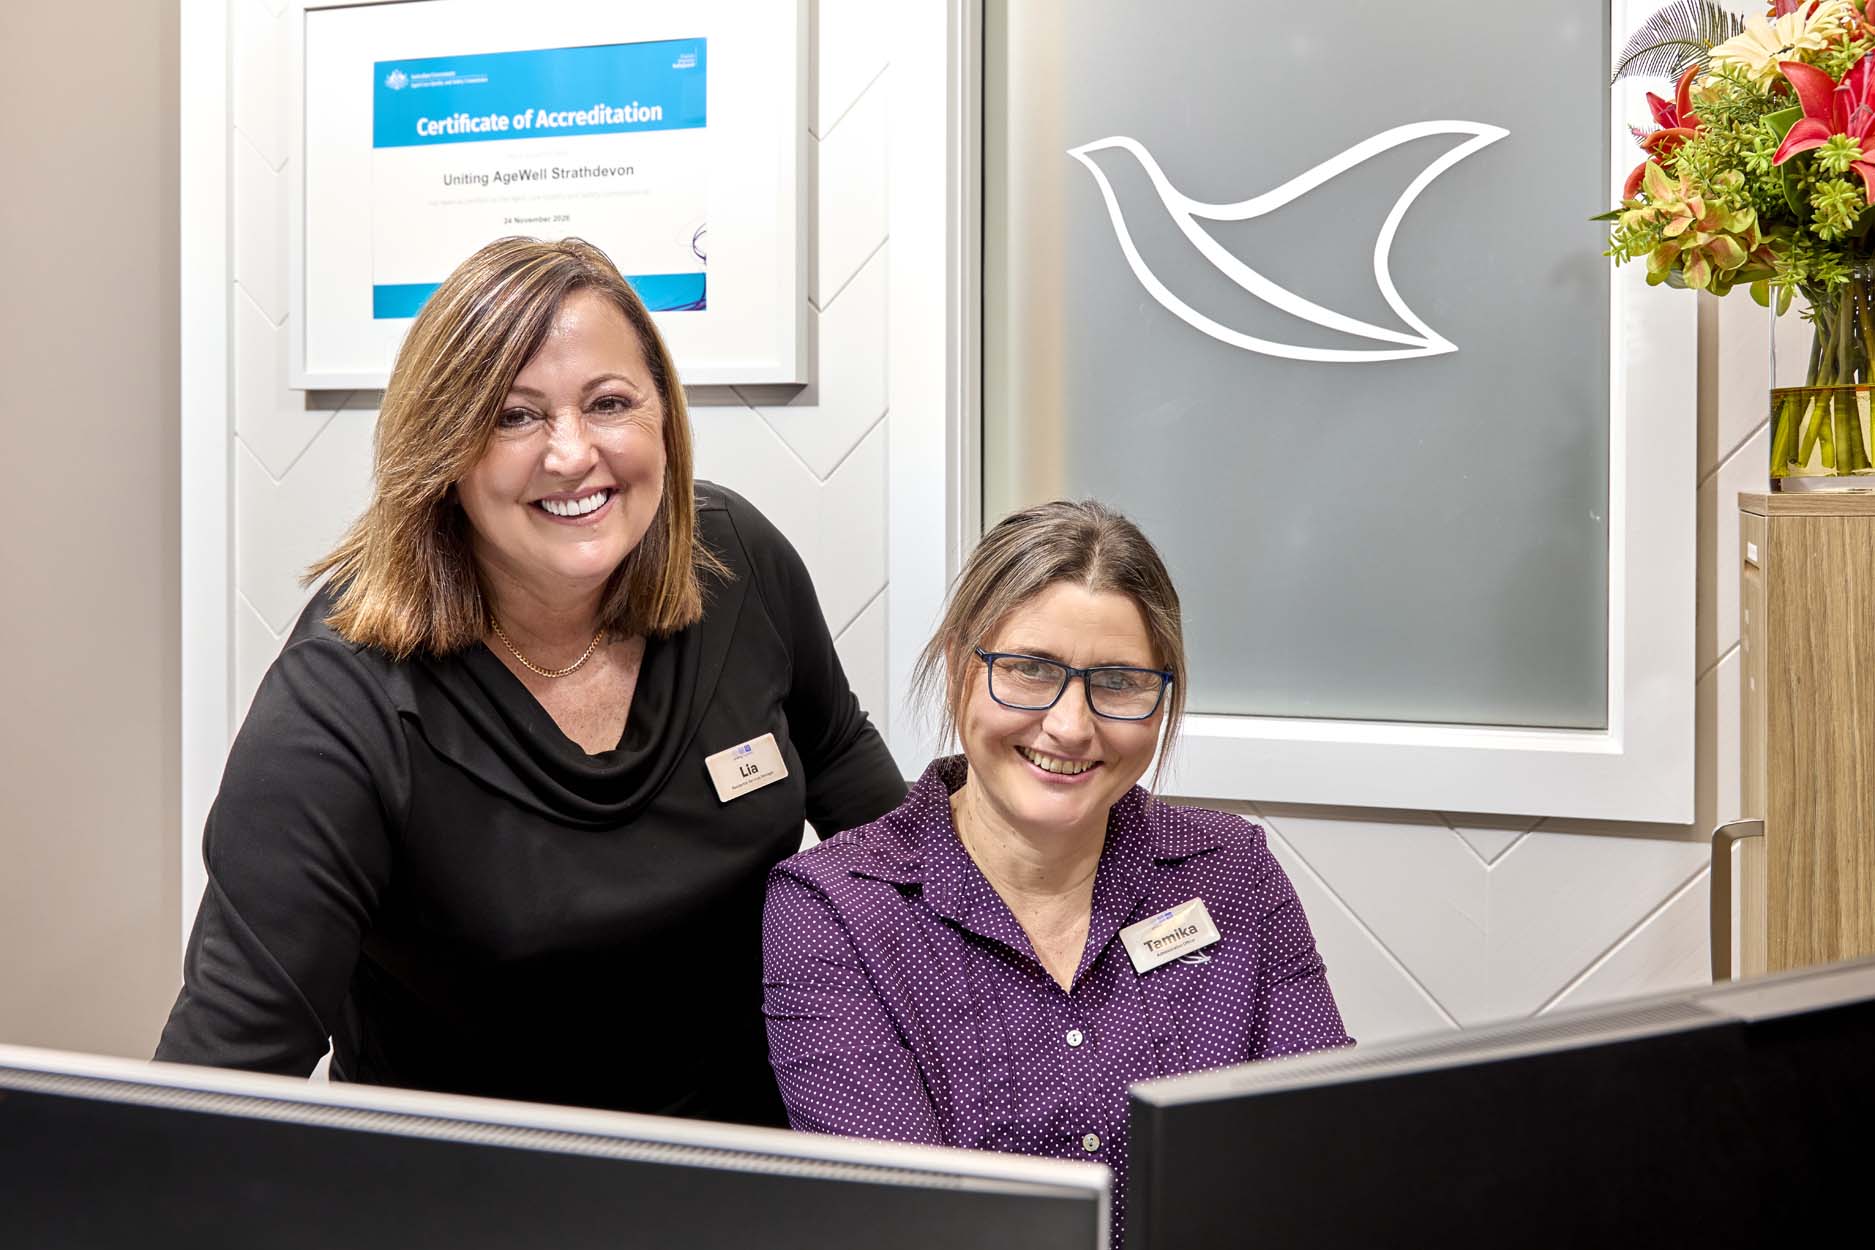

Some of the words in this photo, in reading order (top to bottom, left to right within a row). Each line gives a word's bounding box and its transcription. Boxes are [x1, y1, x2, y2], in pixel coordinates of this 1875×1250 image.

[416, 112, 509, 136] Certificate
[512, 109, 534, 130] of
[535, 101, 662, 128] Accreditation
[443, 172, 489, 187] Uniting
[493, 167, 547, 186] AgeWell
[551, 164, 634, 180] Strathdevon
[513, 214, 551, 225] November
[739, 763, 759, 778] Lia
[1143, 924, 1198, 952] Tamika
